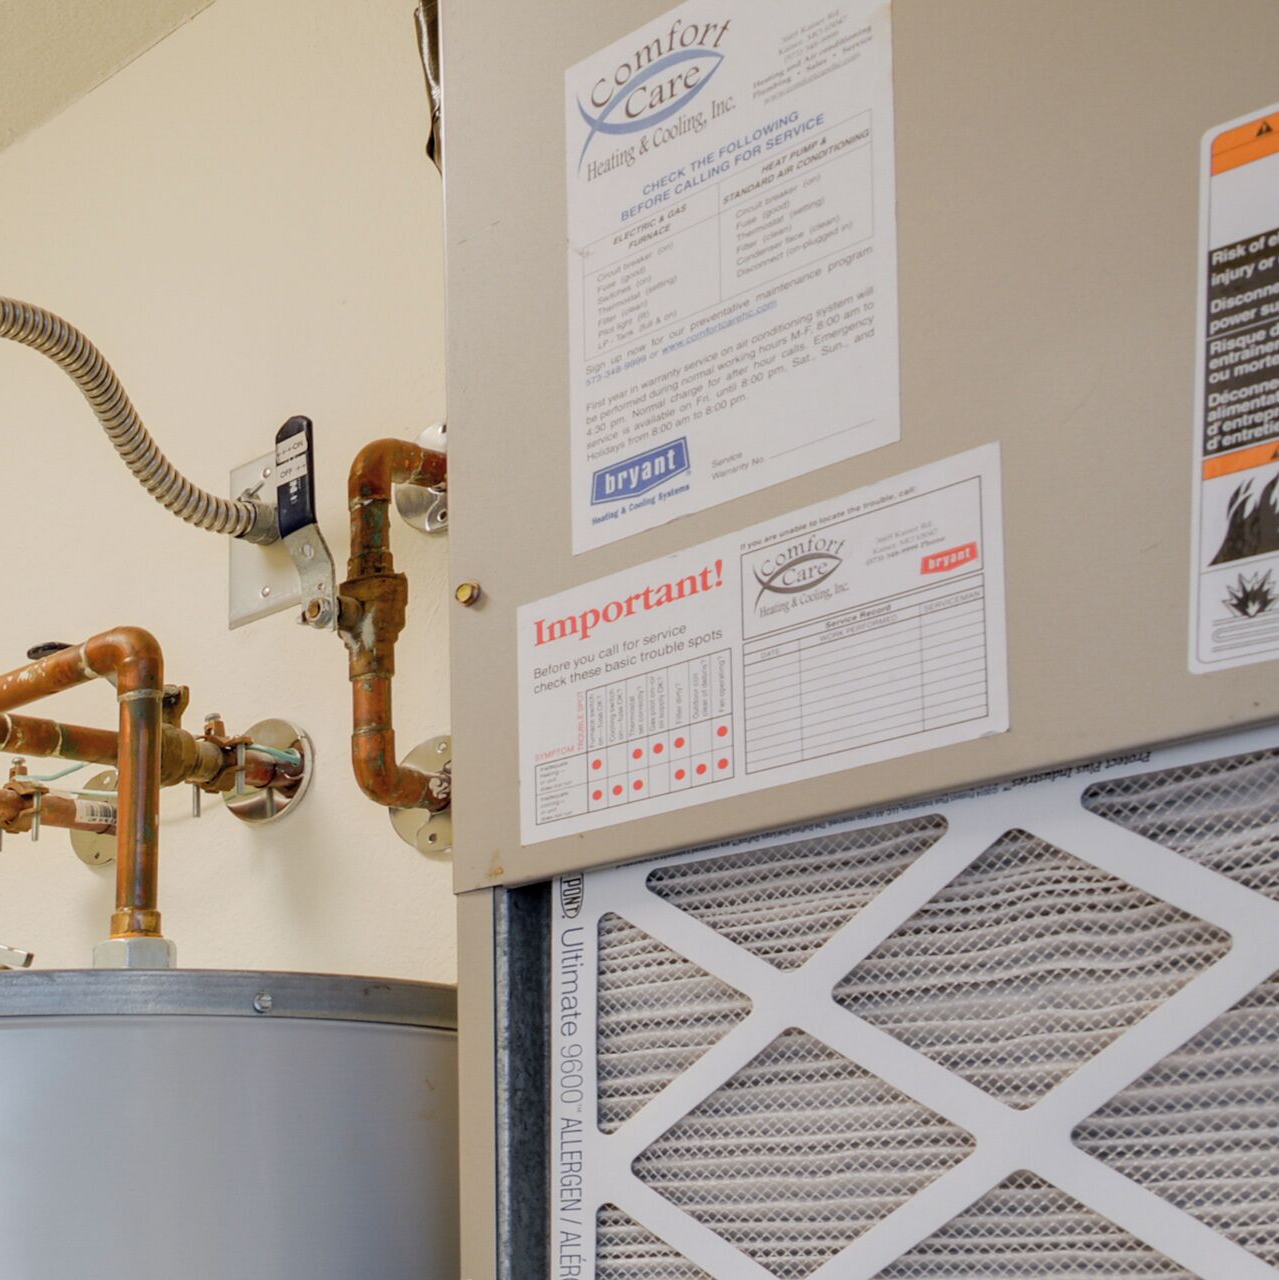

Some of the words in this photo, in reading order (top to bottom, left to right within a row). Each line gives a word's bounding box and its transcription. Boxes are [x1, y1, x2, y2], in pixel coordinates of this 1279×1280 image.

[590, 18, 731, 108] Comfort
[624, 64, 700, 119] Care
[587, 151, 635, 181] Heating
[639, 138, 650, 156] &
[652, 110, 708, 149] Cooling,
[710, 97, 737, 122] Inc.
[642, 167, 685, 195] CHECK
[690, 152, 713, 171] THE
[718, 111, 798, 157] FOLLOWING
[761, 155, 786, 173] HEAT
[789, 140, 817, 159] PUMP
[621, 189, 669, 220] BEFORE
[674, 160, 729, 194] CALLING
[734, 144, 761, 165] FOR
[766, 113, 823, 149] SERVICE
[723, 174, 774, 203] STANDARD
[777, 164, 793, 177] AIR
[796, 129, 869, 168] CONDITIONING
[613, 218, 655, 244] ELECTRIC
[667, 203, 686, 218] GAS
[628, 223, 669, 248] FURNACE
[1212, 242, 1246, 266] Risk
[1249, 236, 1265, 251] of
[1211, 263, 1255, 287] injury
[1258, 256, 1275, 269] or
[585, 361, 605, 375] Sign
[610, 354, 622, 364] up
[626, 344, 646, 356] now
[651, 335, 664, 346] for
[668, 326, 684, 339] our
[690, 299, 749, 331] preventative
[755, 268, 821, 300] maintenance
[1209, 307, 1257, 335] power
[1210, 329, 1267, 356] Risque
[1208, 368, 1230, 384] ou
[292, 441, 304, 450] ON
[586, 441, 625, 461] Holidays
[627, 432, 649, 445] from
[651, 421, 672, 436] 8:00
[675, 415, 690, 427] am
[692, 410, 702, 419] to
[705, 399, 727, 415] 8:00
[604, 452, 677, 494] bryant
[711, 452, 742, 468] Service
[711, 462, 748, 479] Warranty
[591, 510, 618, 524] Heating
[620, 506, 626, 514] &
[628, 496, 655, 511] Cooling
[658, 484, 689, 500] Systems
[779, 523, 806, 537] unable
[818, 511, 844, 523] locate
[846, 505, 860, 514] the
[759, 533, 846, 579] Comfort
[780, 559, 829, 588] Care
[926, 547, 971, 572] bryant
[536, 560, 721, 644] Important!
[759, 601, 789, 617] Heating
[790, 596, 797, 607] &
[825, 611, 857, 630] Service
[859, 600, 891, 620] Record
[533, 661, 570, 679] Before
[573, 654, 594, 669] you
[598, 643, 618, 659] call
[622, 639, 639, 651] for
[642, 624, 686, 645] service
[533, 676, 566, 693] check
[570, 666, 601, 683] these
[604, 655, 636, 672] basic
[640, 641, 684, 661] trouble
[688, 629, 722, 647] spots
[559, 927, 584, 1037] Ultimate
[559, 1118, 582, 1212] ALLERGEN
[559, 1216, 582, 1226] /
